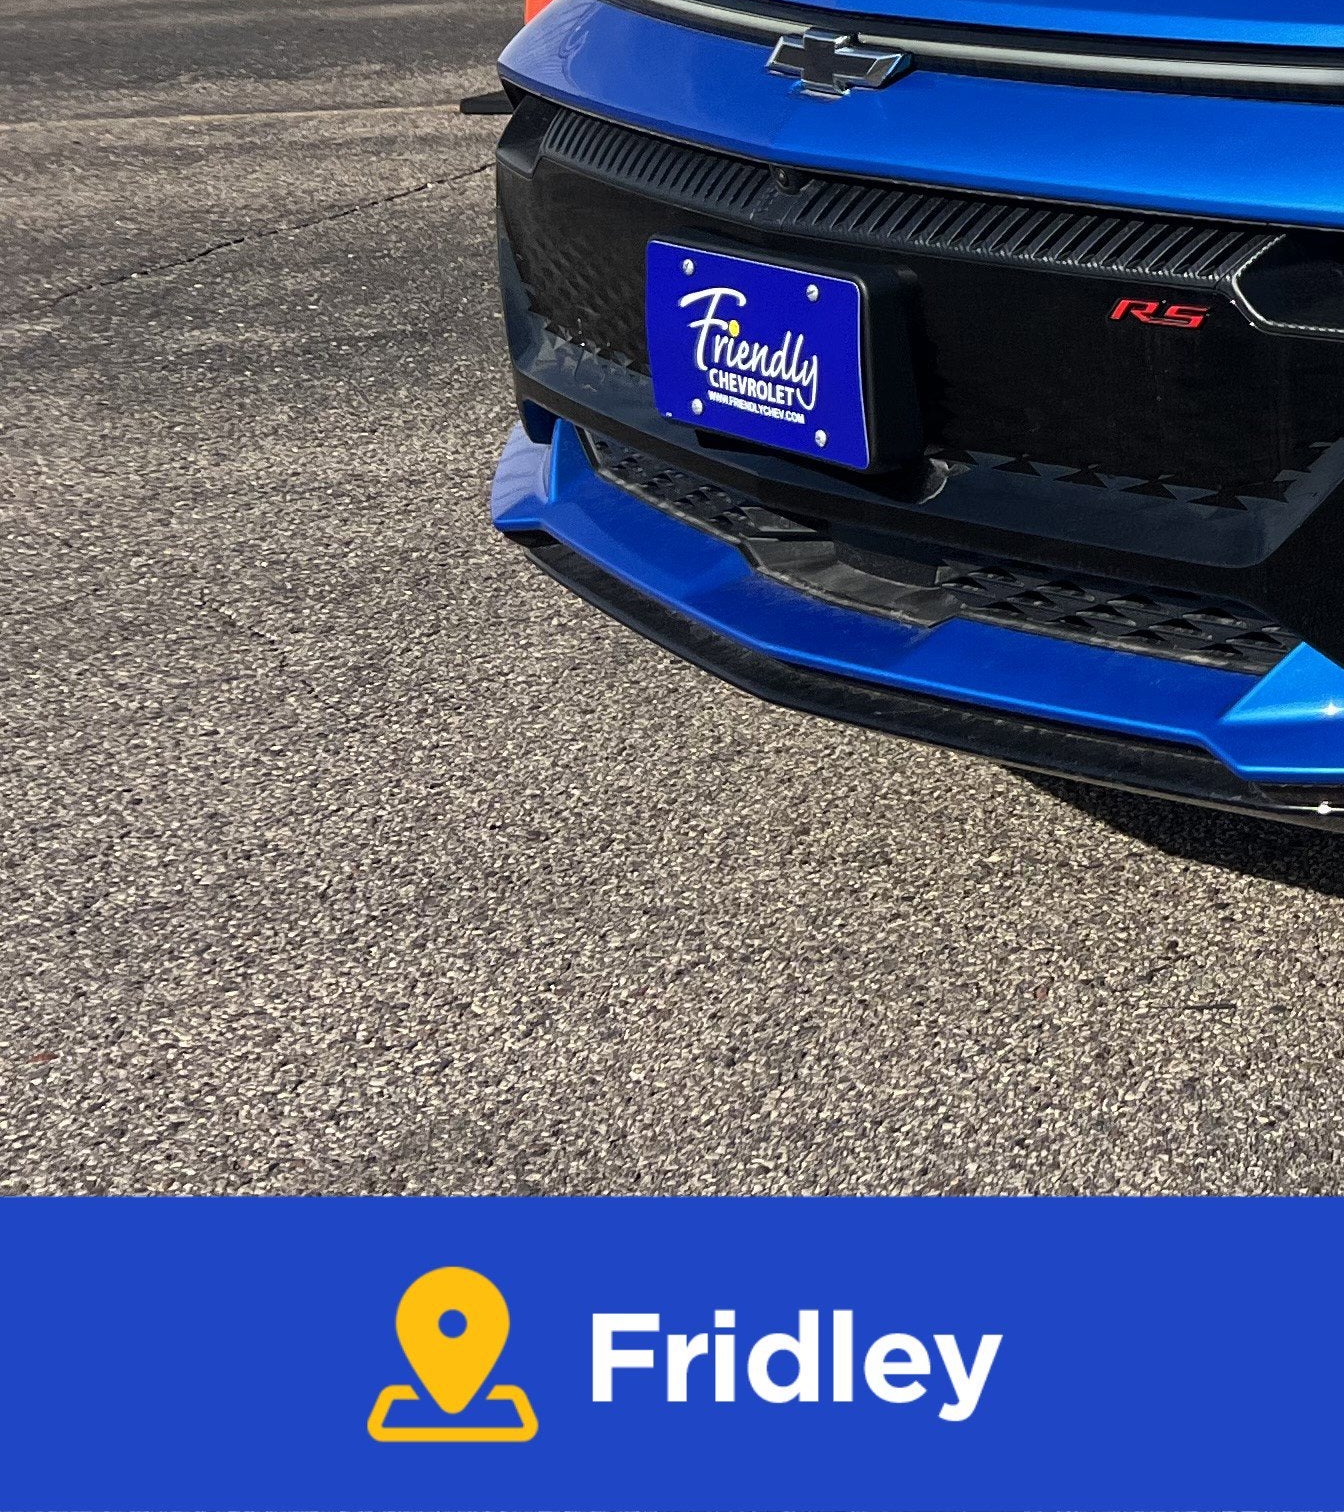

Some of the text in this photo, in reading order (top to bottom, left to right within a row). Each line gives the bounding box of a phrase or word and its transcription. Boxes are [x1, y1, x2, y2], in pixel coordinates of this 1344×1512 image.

[1108, 297, 1210, 329] RS
[678, 287, 819, 411] Friendly
[708, 367, 796, 407] CHEVROLET
